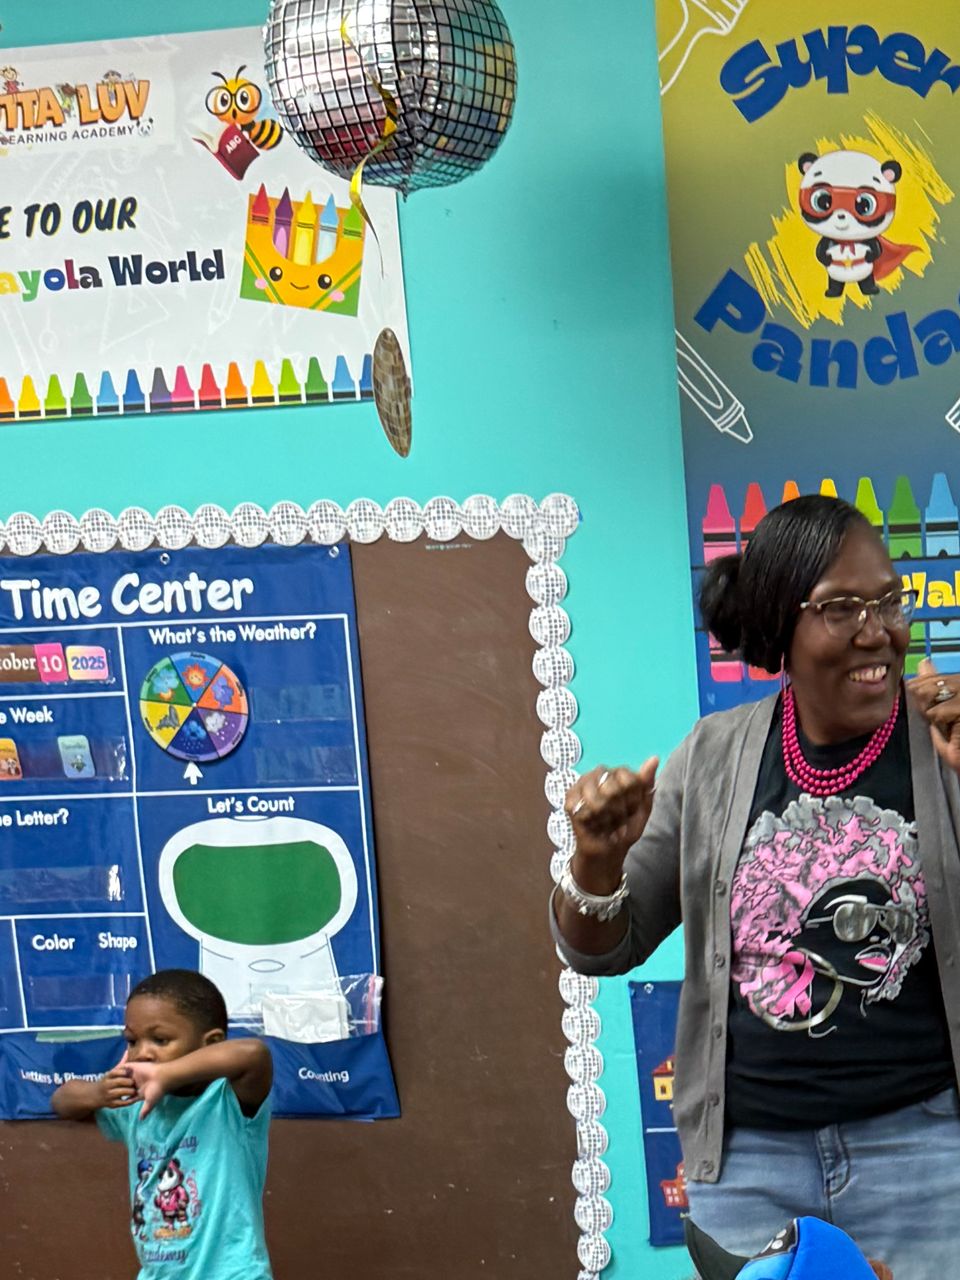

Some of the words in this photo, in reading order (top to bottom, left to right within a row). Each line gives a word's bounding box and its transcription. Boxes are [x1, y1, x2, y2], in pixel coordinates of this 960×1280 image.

[76, 79, 151, 126] LUV
[72, 124, 134, 140] ACADEMY
[225, 135, 243, 154] ABC
[23, 202, 62, 238] TO
[72, 196, 138, 235] OUR
[107, 248, 226, 288] World
[0, 579, 102, 621] Time
[111, 572, 254, 615] Center
[149, 626, 206, 645] What's
[209, 624, 237, 643] the
[237, 621, 318, 643] Weather?
[41, 655, 63, 673] 10
[70, 655, 106, 671] 2025
[9, 705, 54, 724] Week
[207, 796, 244, 814] Let's
[247, 795, 296, 812] Count
[16, 808, 70, 827] Letter?
[32, 933, 76, 951] Color
[98, 931, 138, 952] Shape
[54, 1071, 63, 1086] &
[298, 1065, 351, 1085] Counting
